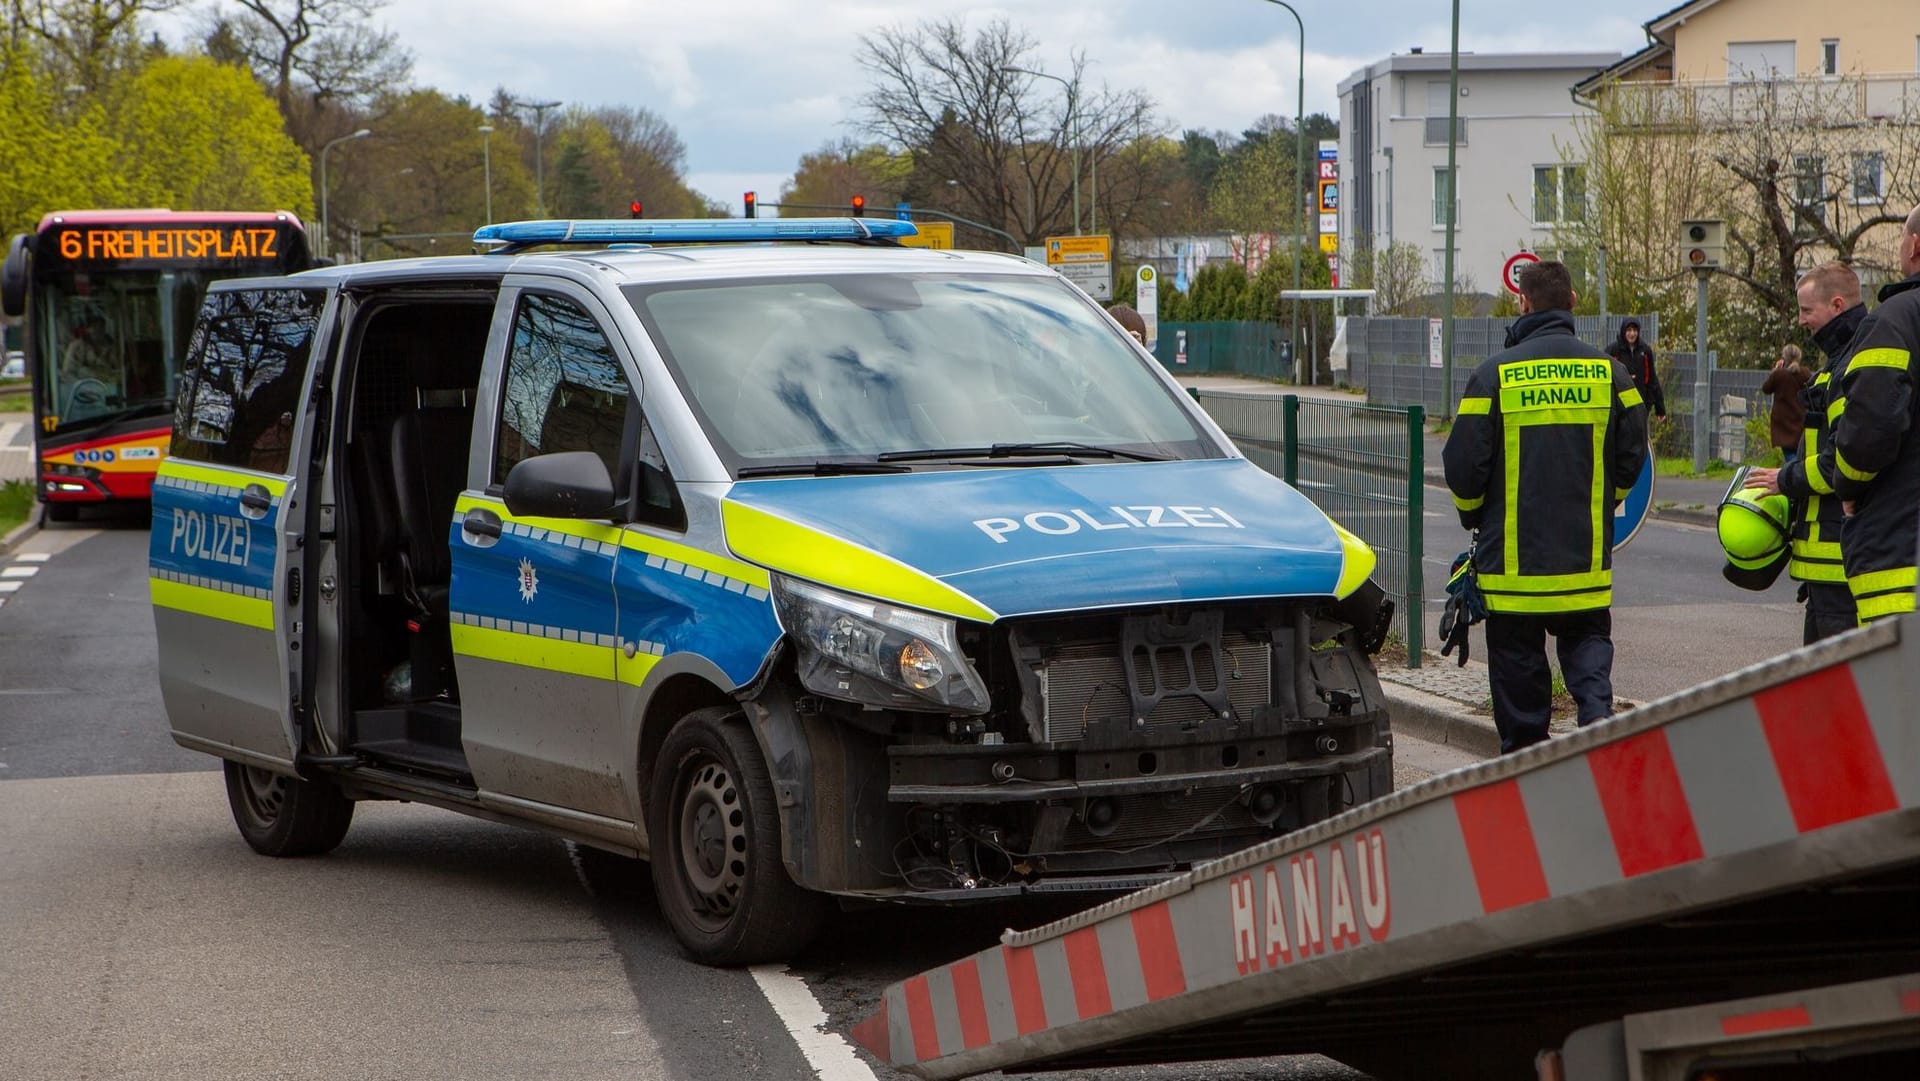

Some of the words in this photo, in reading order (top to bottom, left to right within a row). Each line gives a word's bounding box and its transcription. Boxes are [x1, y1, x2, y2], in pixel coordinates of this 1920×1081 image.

[60, 230, 83, 259] 6
[87, 229, 277, 259] FREIHEITSPLATZ
[1503, 364, 1608, 383] FEUERWEHR
[1520, 387, 1592, 407] HANAU
[41, 416, 60, 433] 17
[170, 507, 251, 567] POLIZEI
[972, 505, 1246, 544] POLIZEI
[1229, 827, 1393, 976] HANAU
